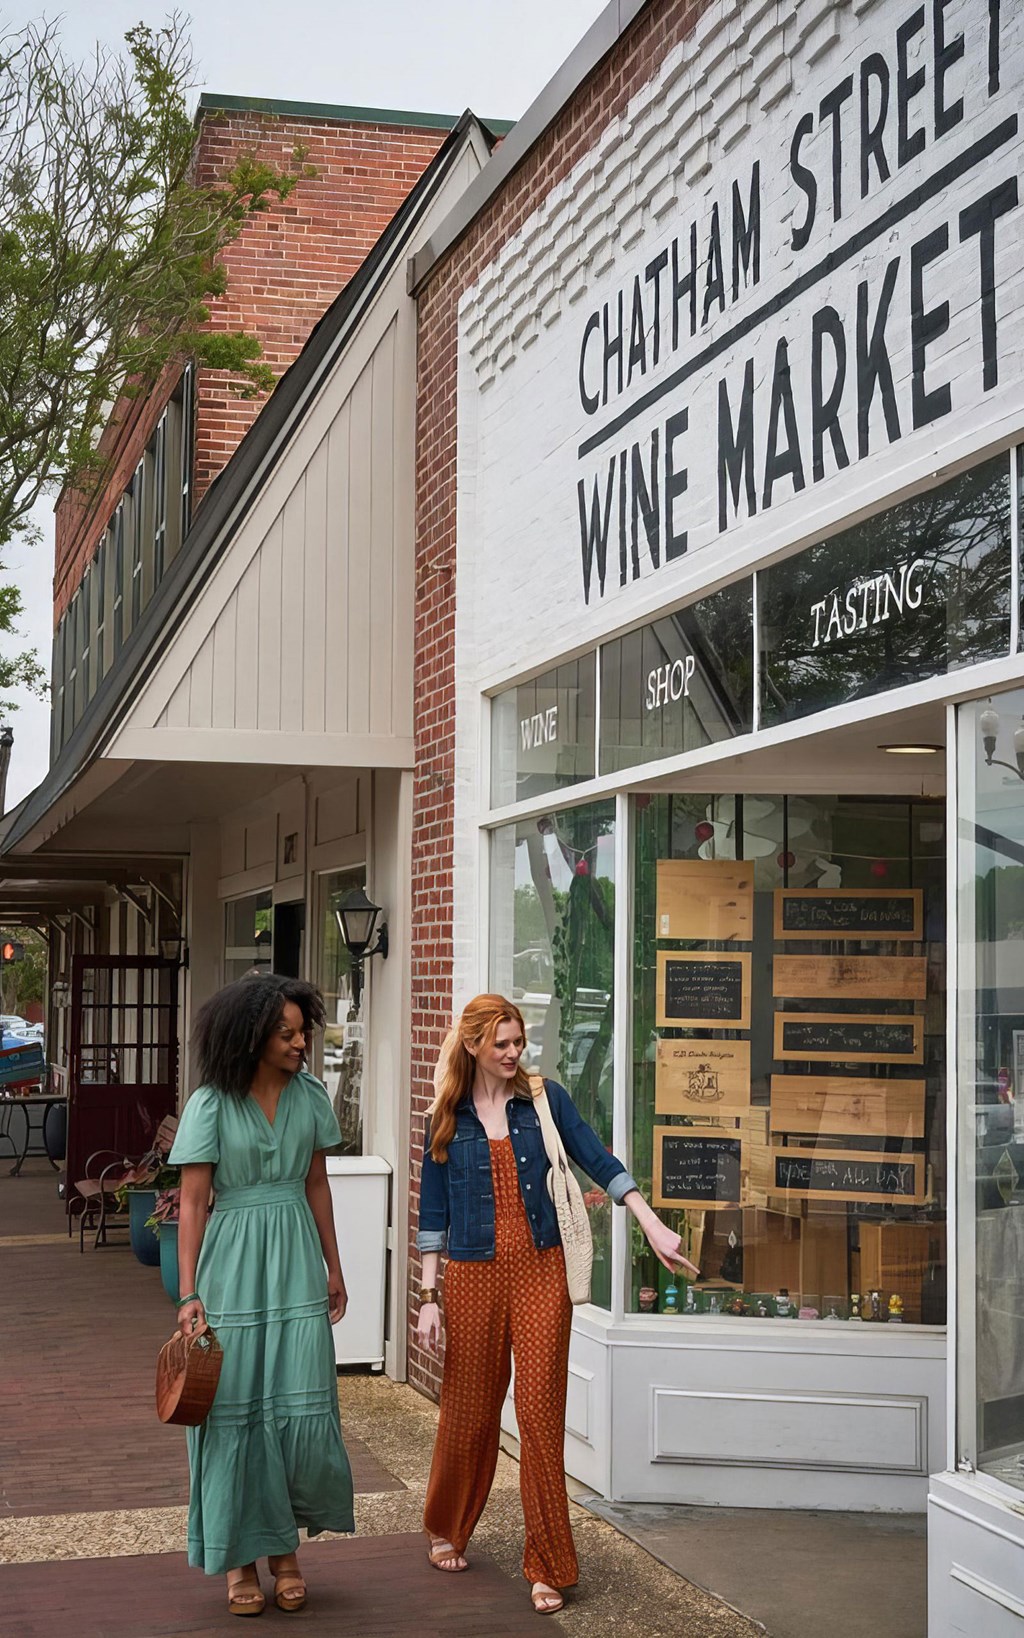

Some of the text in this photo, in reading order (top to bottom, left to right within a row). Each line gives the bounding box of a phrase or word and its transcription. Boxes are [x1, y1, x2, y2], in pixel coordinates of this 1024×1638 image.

[577, 175, 1019, 606] WINE MARKET
[578, 159, 761, 416] CHATHAM
[520, 559, 926, 753] WINE SHOP TASTING
